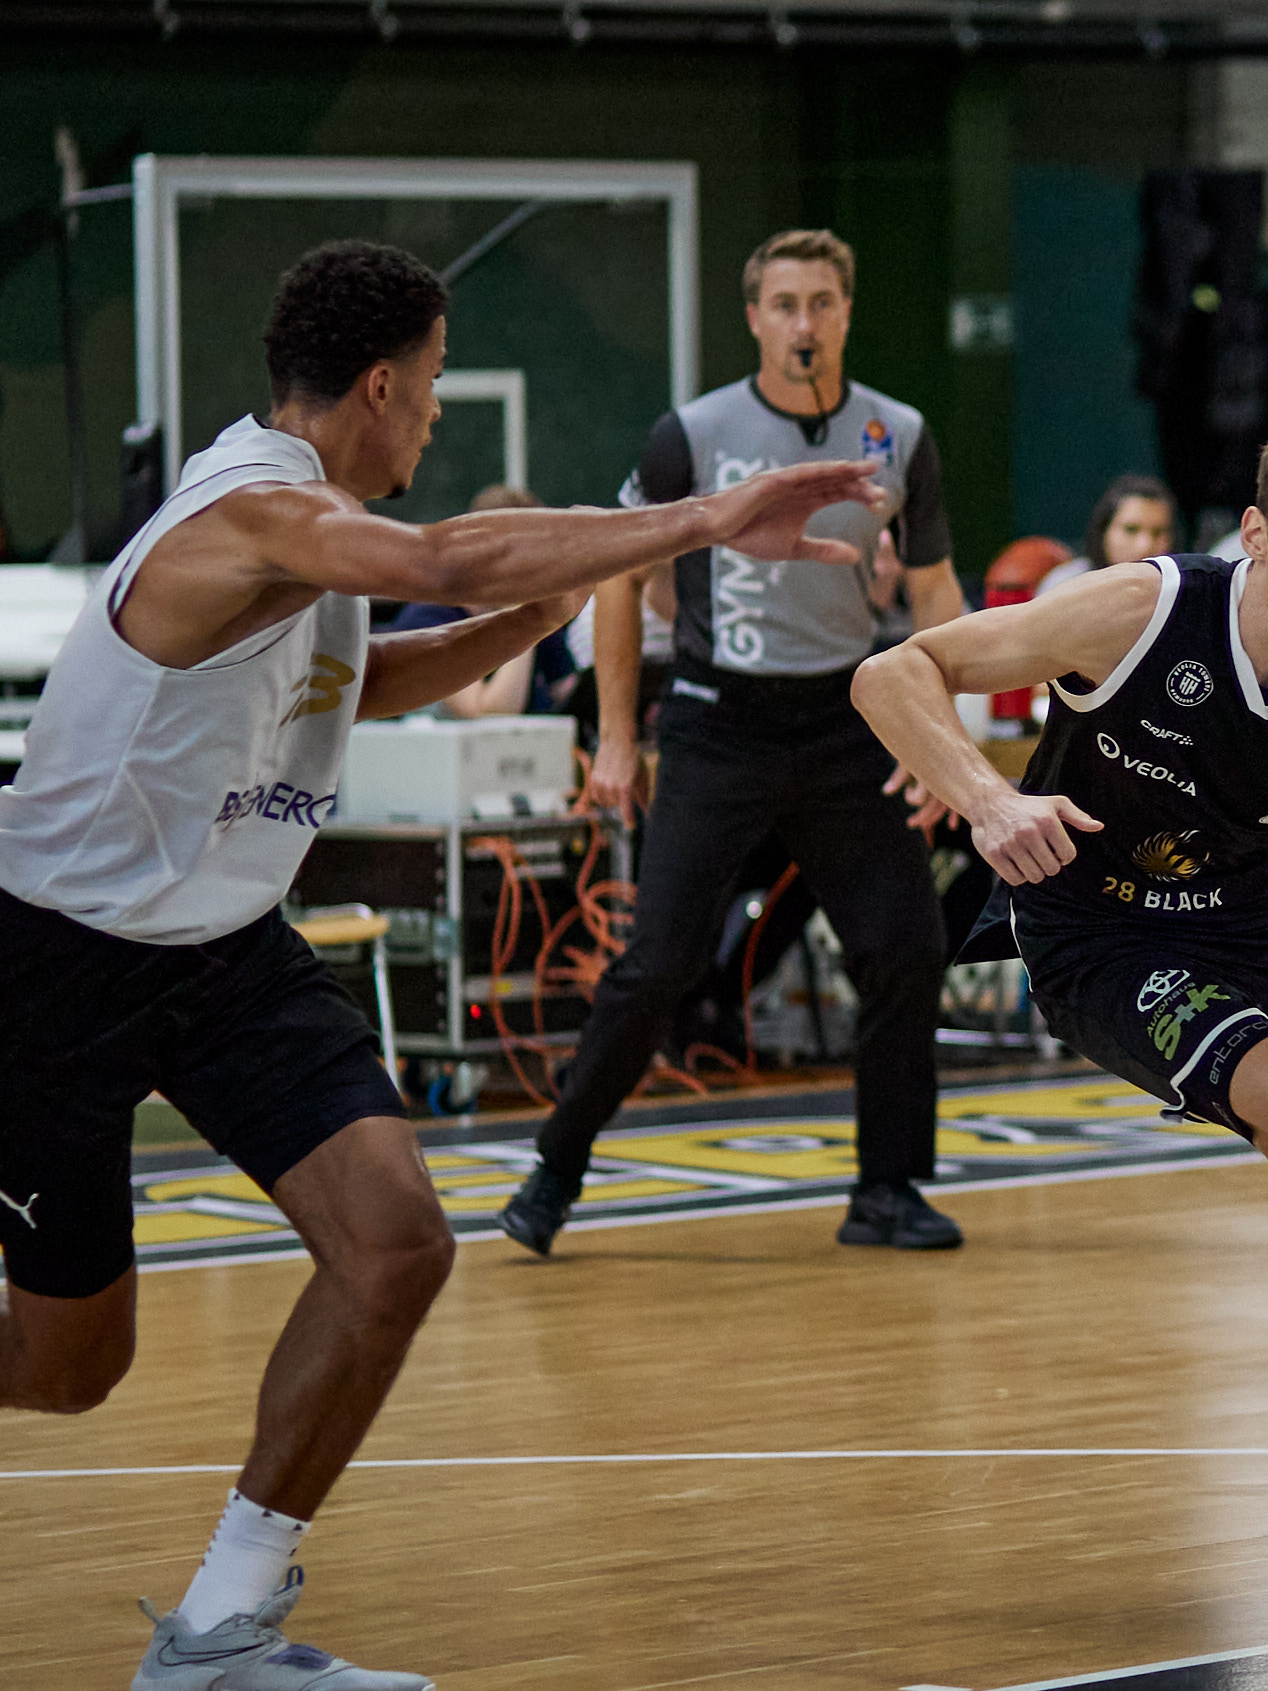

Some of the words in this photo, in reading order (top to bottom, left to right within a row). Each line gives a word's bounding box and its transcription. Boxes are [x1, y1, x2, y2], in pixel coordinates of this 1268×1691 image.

[1140, 719, 1184, 741] CRAFT
[1123, 754, 1197, 797] VEOLIA
[1102, 876, 1136, 902] 28
[1144, 887, 1223, 912] BLACK
[1146, 982, 1197, 1038] Autohaus
